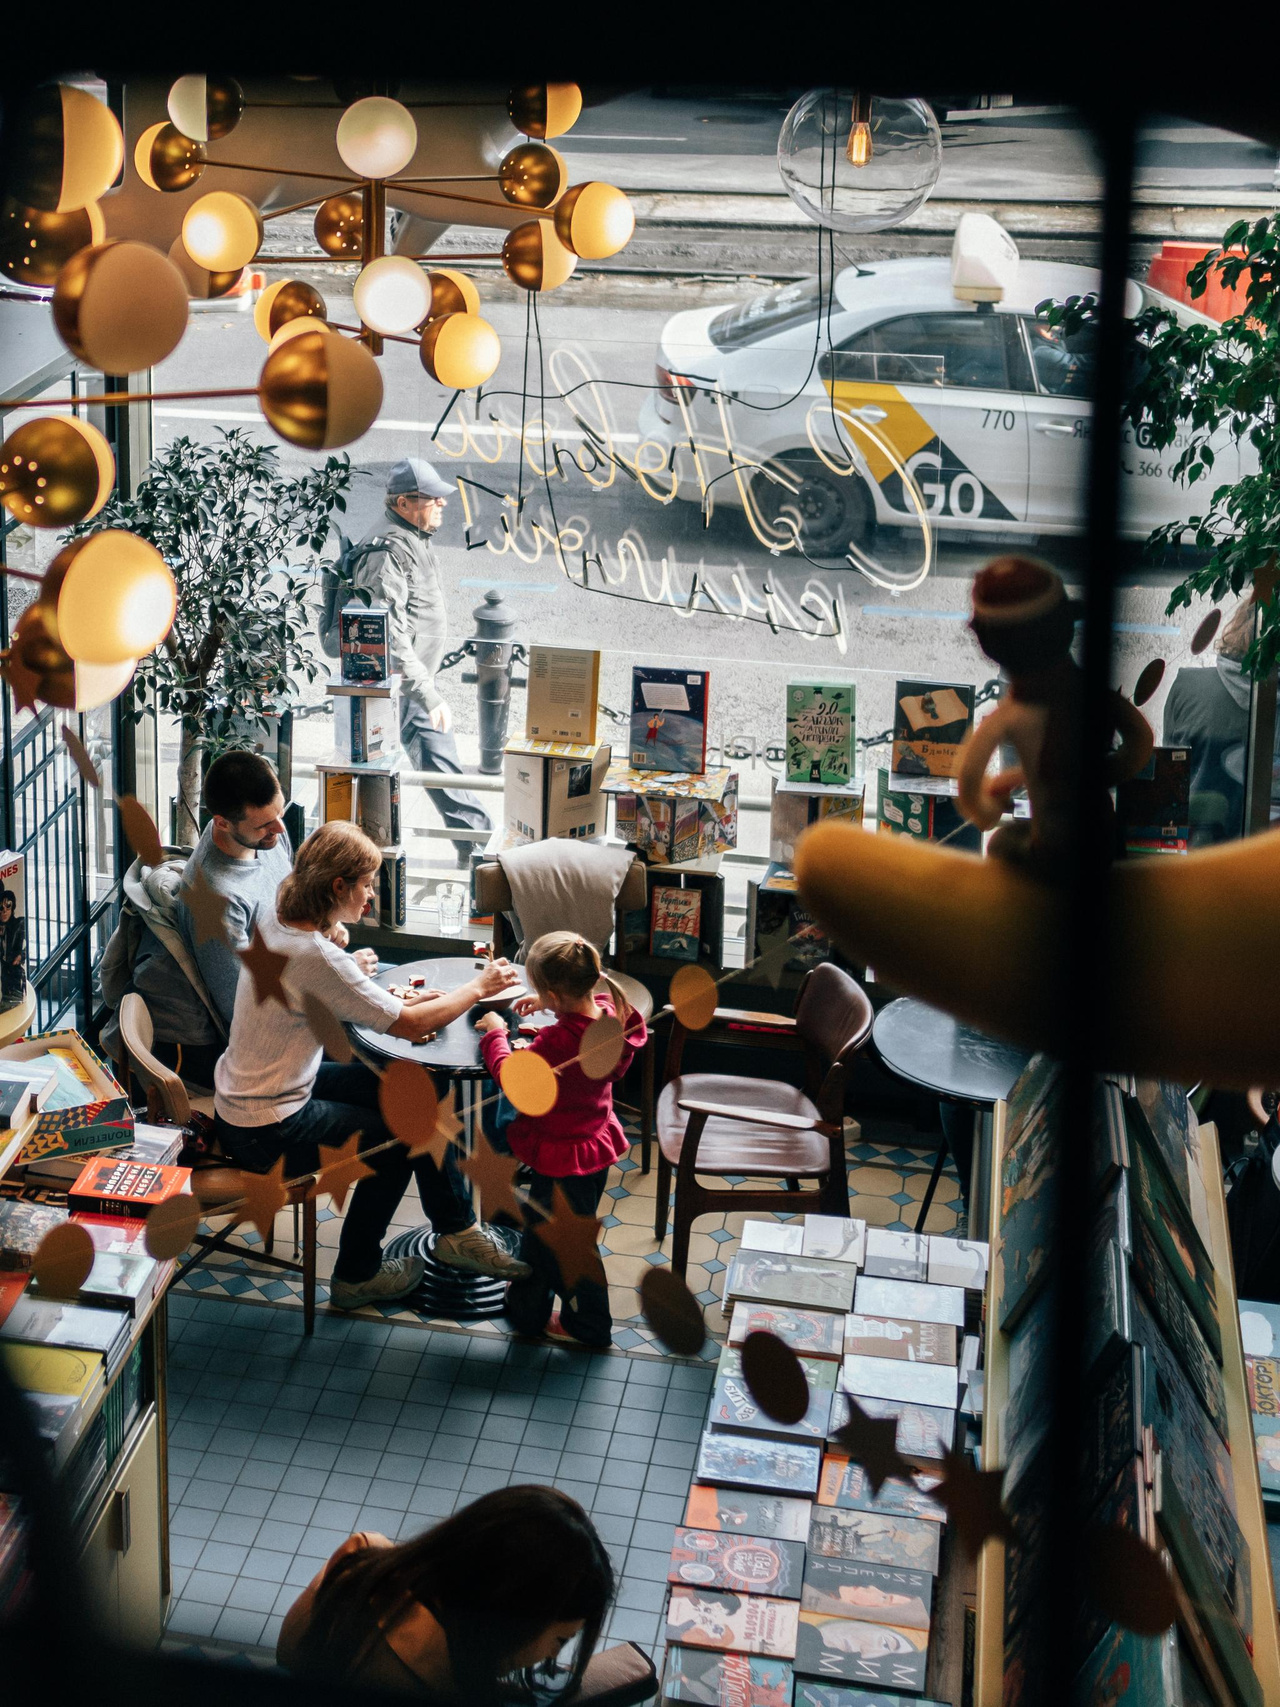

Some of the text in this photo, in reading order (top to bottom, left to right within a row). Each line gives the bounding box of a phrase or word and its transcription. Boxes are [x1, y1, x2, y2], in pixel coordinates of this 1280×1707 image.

[981, 408, 1015, 431] 770
[74, 1129, 132, 1147] ПОЛЕТЕЛИ
[102, 1163, 127, 1194] ИМПЕРИЯ
[116, 1164, 142, 1196] ДОЛЖНА
[132, 1166, 158, 1198] УМЕРЕТЬ
[810, 1558, 923, 1588] МИРЕЛЛА
[742, 1597, 760, 1643] РОБОТЫ
[817, 1651, 918, 1688] МИМ
